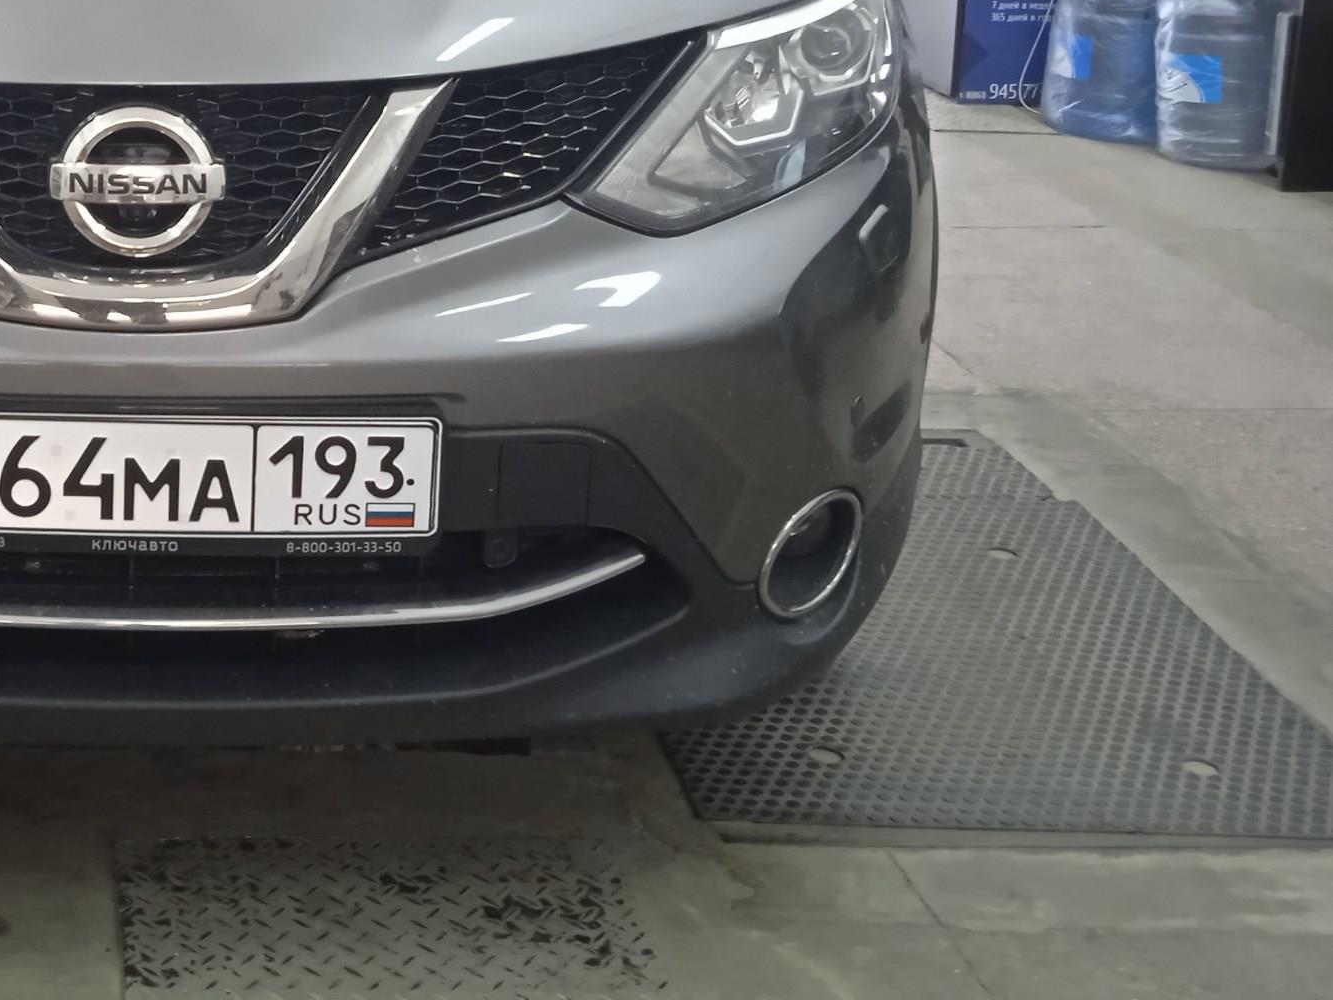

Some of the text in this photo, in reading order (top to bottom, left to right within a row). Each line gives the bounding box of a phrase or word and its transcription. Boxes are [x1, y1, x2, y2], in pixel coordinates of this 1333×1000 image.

[988, 83, 1018, 100] 945
[69, 172, 207, 195] NISSAN
[268, 435, 407, 500] 193
[293, 503, 362, 526] RUS
[286, 542, 402, 553] 8-800-301-33-50
